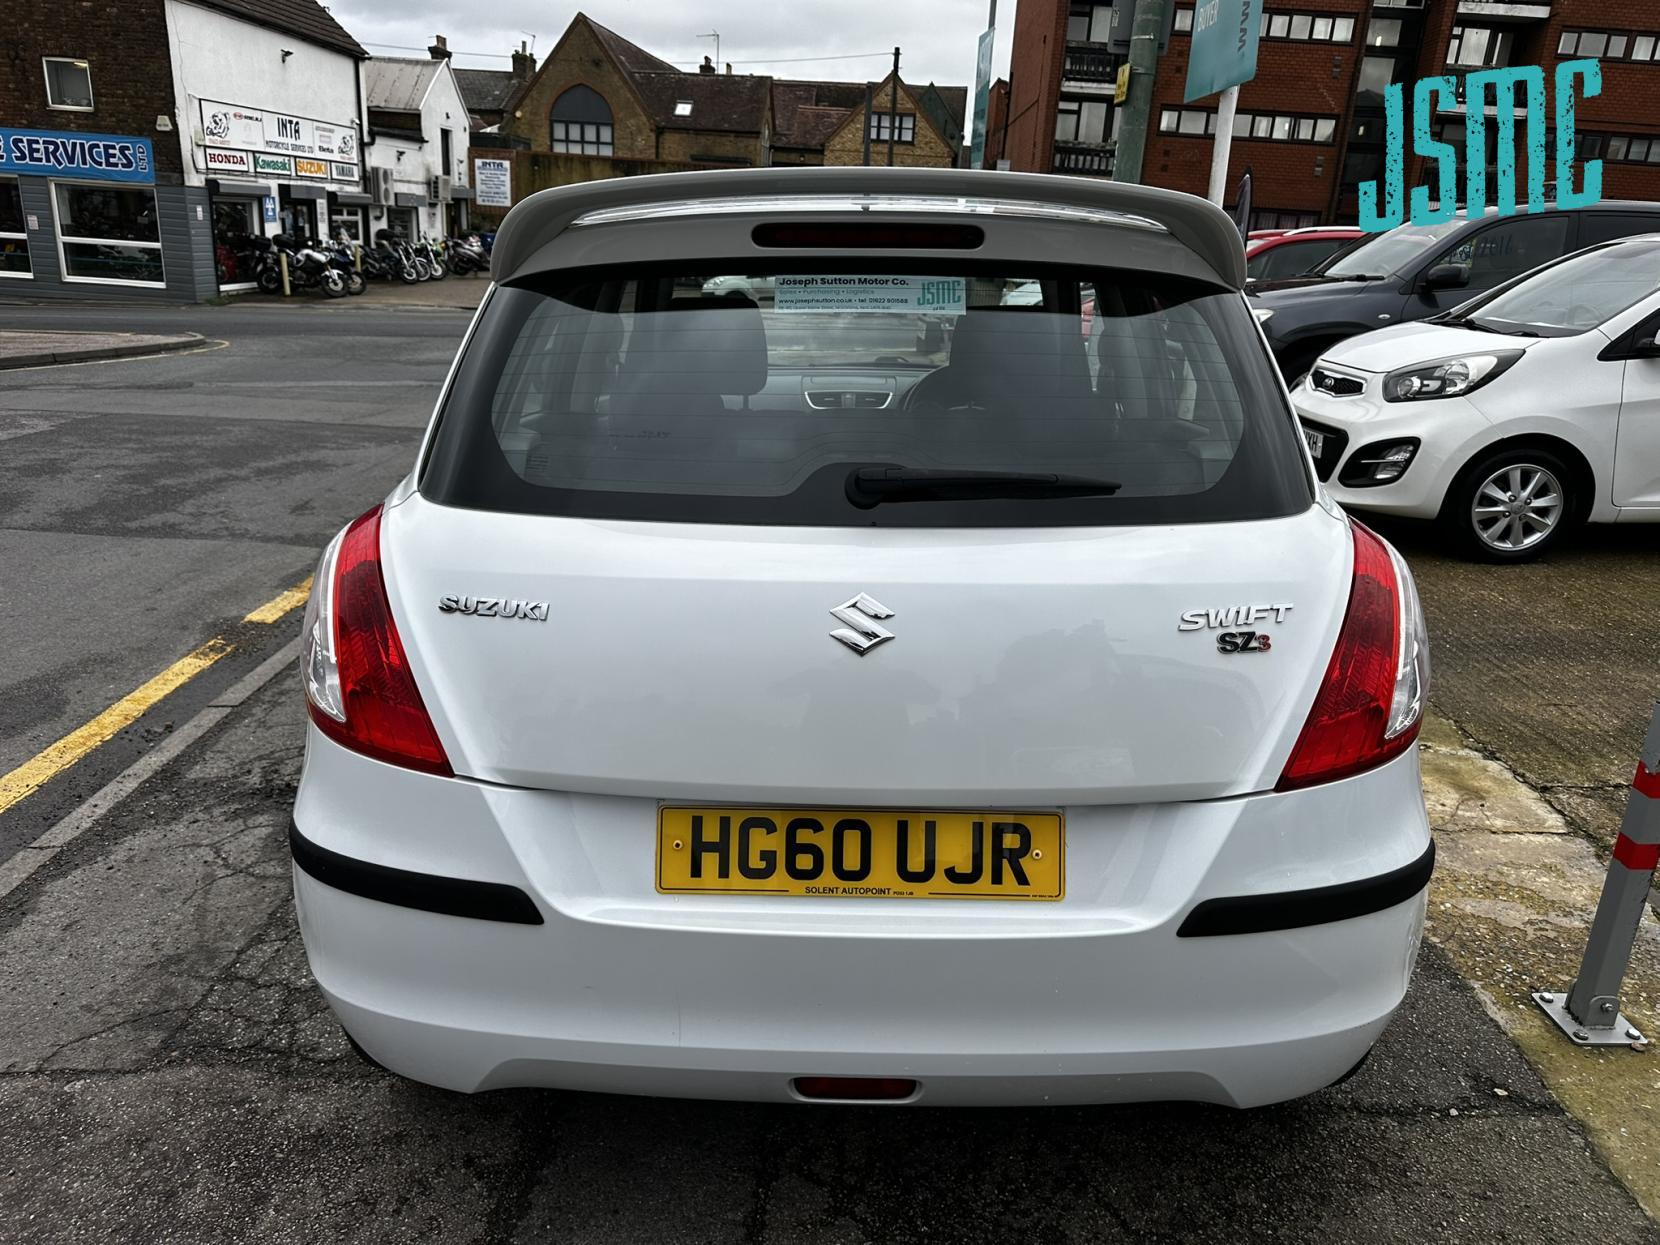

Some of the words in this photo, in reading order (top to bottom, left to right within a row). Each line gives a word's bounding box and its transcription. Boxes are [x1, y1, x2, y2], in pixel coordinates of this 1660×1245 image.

[277, 117, 301, 141] INTA
[11, 135, 135, 171] SERVICES
[136, 144, 148, 172] LTD
[208, 153, 246, 166] HONDA
[255, 154, 291, 172] Kawasaki
[296, 159, 327, 175] SUZUKI
[779, 277, 818, 287] Joseph
[820, 277, 856, 285] Sutton
[858, 277, 890, 285] Motor
[891, 278, 909, 286] Co.
[917, 280, 961, 306] JSMC
[438, 594, 550, 621] SUZUKI
[1177, 602, 1294, 632] SWIFT
[1216, 631, 1272, 654] SZ3
[689, 815, 872, 882] HG60
[896, 819, 1032, 887] UJR
[805, 886, 840, 895] SOLENT
[840, 887, 891, 896] AUTOPOINT
